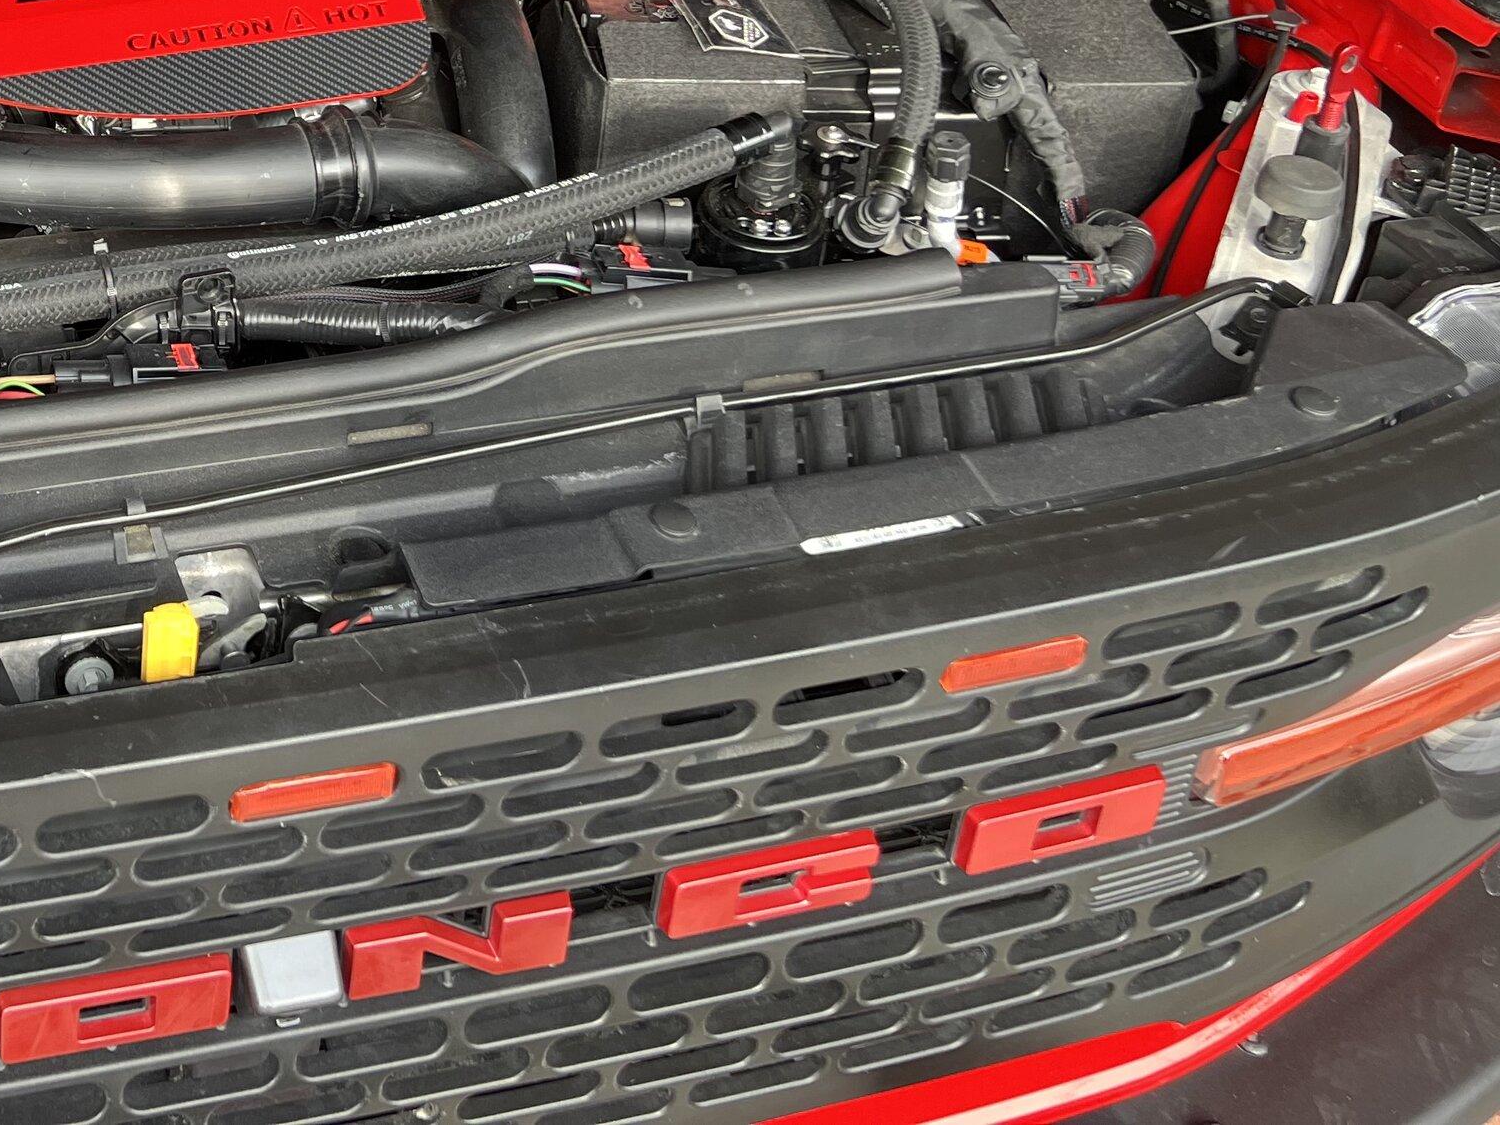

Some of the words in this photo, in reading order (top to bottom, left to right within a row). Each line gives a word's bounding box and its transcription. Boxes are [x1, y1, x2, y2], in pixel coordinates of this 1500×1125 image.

[127, 17, 273, 52] CAUTION
[324, 0, 388, 26] HOT
[460, 205, 481, 215] 300
[500, 194, 521, 204] WP
[524, 183, 560, 198] MADE
[559, 179, 574, 188] IN
[572, 172, 598, 183] USA
